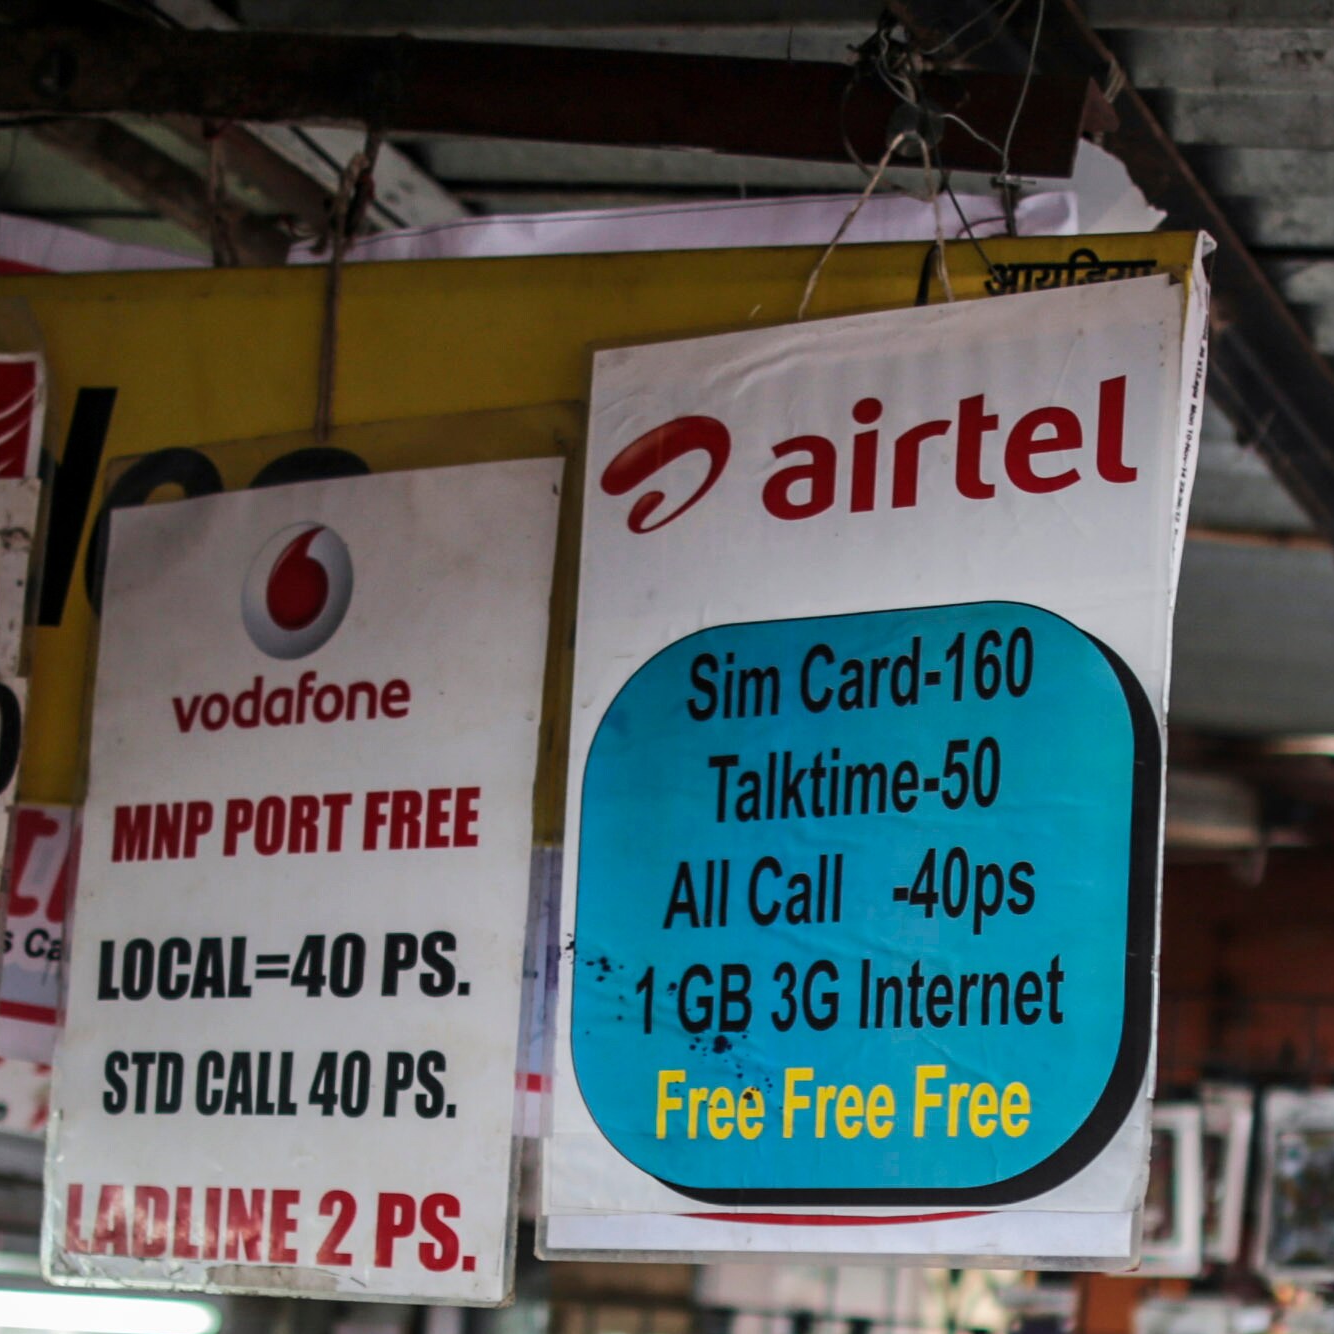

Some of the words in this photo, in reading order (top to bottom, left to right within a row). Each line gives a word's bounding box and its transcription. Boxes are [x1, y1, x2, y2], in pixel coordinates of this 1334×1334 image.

[762, 375, 1137, 520] airtel
[173, 671, 410, 733] vodafone
[686, 652, 779, 722] Sim
[800, 626, 1033, 714] Card-160
[708, 737, 1000, 823] Talktime-50
[111, 801, 213, 862] MNP
[222, 794, 352, 857] PORT
[363, 787, 481, 851] FREE
[664, 860, 729, 930] All
[748, 853, 843, 926] Call
[893, 847, 1035, 935] -40ps
[97, 932, 366, 1000] LOCAL=40
[381, 931, 470, 997] PS.
[636, 967, 654, 1034] 1
[677, 964, 753, 1033] GB
[771, 960, 840, 1032] 3G
[859, 955, 1064, 1029] Internet
[103, 1051, 184, 1115] STD
[196, 1051, 296, 1116] CALL
[309, 1051, 370, 1118] 40
[383, 1051, 456, 1119] PS.
[656, 1069, 765, 1140] Free
[783, 1068, 895, 1139] Free
[913, 1065, 1031, 1139] Free
[65, 1184, 300, 1263] LADLINE
[316, 1190, 357, 1266] 2
[375, 1192, 475, 1271] PS.
